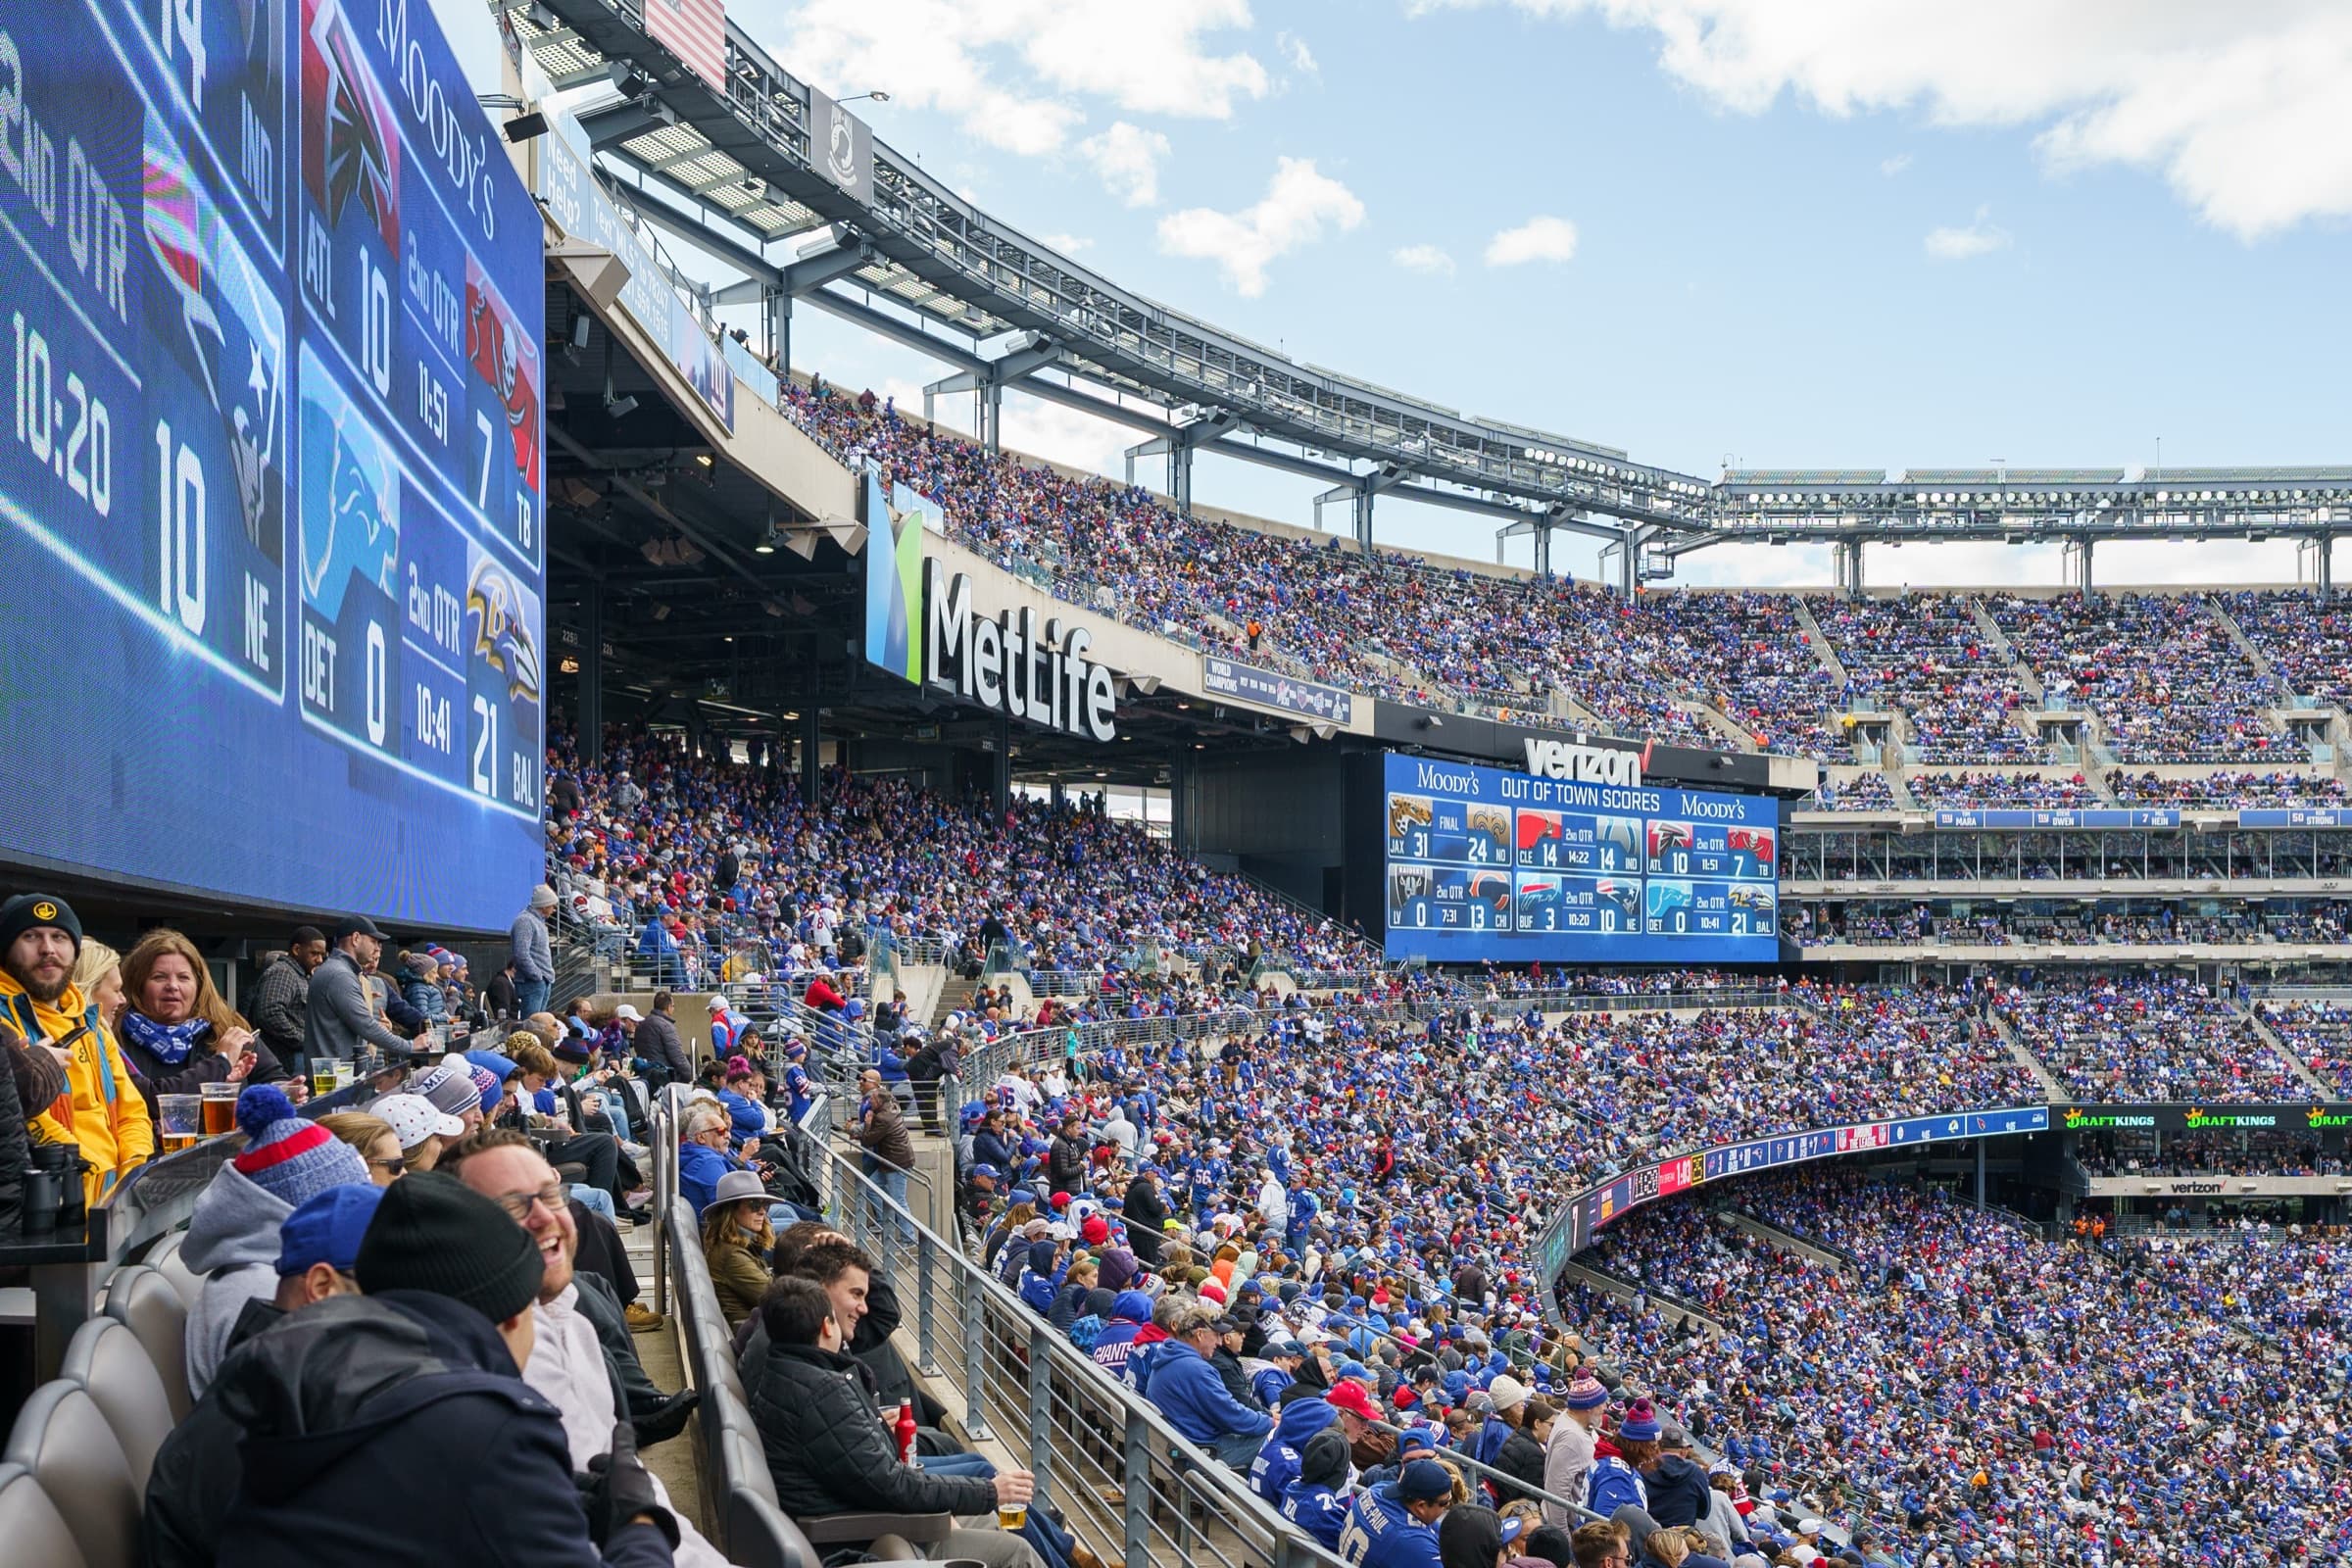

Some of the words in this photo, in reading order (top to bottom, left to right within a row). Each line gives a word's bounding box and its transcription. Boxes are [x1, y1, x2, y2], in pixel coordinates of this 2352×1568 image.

[241, 89, 272, 220] IND
[547, 132, 576, 191] Need
[547, 172, 581, 233] Help?
[594, 198, 612, 241] Text
[306, 209, 336, 320] ATL
[360, 244, 390, 399] 10
[13, 310, 111, 517] 10:20
[418, 360, 447, 447] 11:51
[476, 409, 493, 510] 7
[157, 417, 206, 636] 10
[516, 490, 531, 550] TB
[245, 570, 270, 672] NE
[923, 557, 1116, 742] MetLife
[305, 619, 337, 712] DET
[1210, 661, 1232, 677] WORLD
[367, 619, 386, 747] 0
[1206, 672, 1238, 693] CHAMPIONS
[416, 682, 451, 755] 10:41
[472, 694, 497, 799] 21
[1523, 735, 1642, 788] verizon
[513, 751, 534, 808] BAL
[1501, 777, 1530, 800] OUT
[1533, 780, 1551, 802] OF
[1554, 783, 1598, 808] TOWN
[1602, 789, 1660, 811] SCORES
[1439, 816, 1460, 831] FINAL
[1955, 816, 1977, 826] MARA
[2052, 815, 2075, 826] OWEN
[2142, 812, 2149, 823] 7
[2291, 812, 2304, 822] 50
[2306, 815, 2334, 825] STRONG
[1390, 839, 1405, 855] JAX
[1413, 832, 1428, 858] 31
[1468, 837, 1488, 861] 24
[1495, 849, 1506, 861] NO
[1543, 843, 1557, 866] 14
[1519, 850, 1533, 863] CLE
[1568, 851, 1590, 863] 14:22
[1599, 848, 1615, 870] 14
[1625, 858, 1638, 870] IND
[1649, 858, 1663, 872] ATL
[1672, 852, 1689, 874] 10
[1701, 858, 1719, 871] 11:51
[1734, 856, 1744, 877] 7
[1758, 864, 1769, 876] TB
[1393, 910, 1401, 925] LV
[1416, 903, 1427, 927] 0
[1442, 908, 1457, 923] 7:31
[1470, 905, 1485, 929] 13
[1494, 914, 1507, 928] CHI
[1519, 915, 1533, 928] BUF
[1544, 907, 1555, 930] 3
[1568, 913, 1590, 926] 10:20
[1599, 908, 1615, 931] 10
[1627, 918, 1637, 931] NE
[1648, 918, 1663, 931] DET
[1675, 911, 1686, 933] 0
[1700, 916, 1720, 929] 10:41
[1732, 912, 1747, 935] 21
[1756, 921, 1771, 933] BAL
[2067, 1115, 2155, 1128] DRAFTKINGS
[2187, 1115, 2276, 1128] DRAFTKINGS
[1196, 1169, 1211, 1185] 56
[2171, 1181, 2221, 1193] verizon
